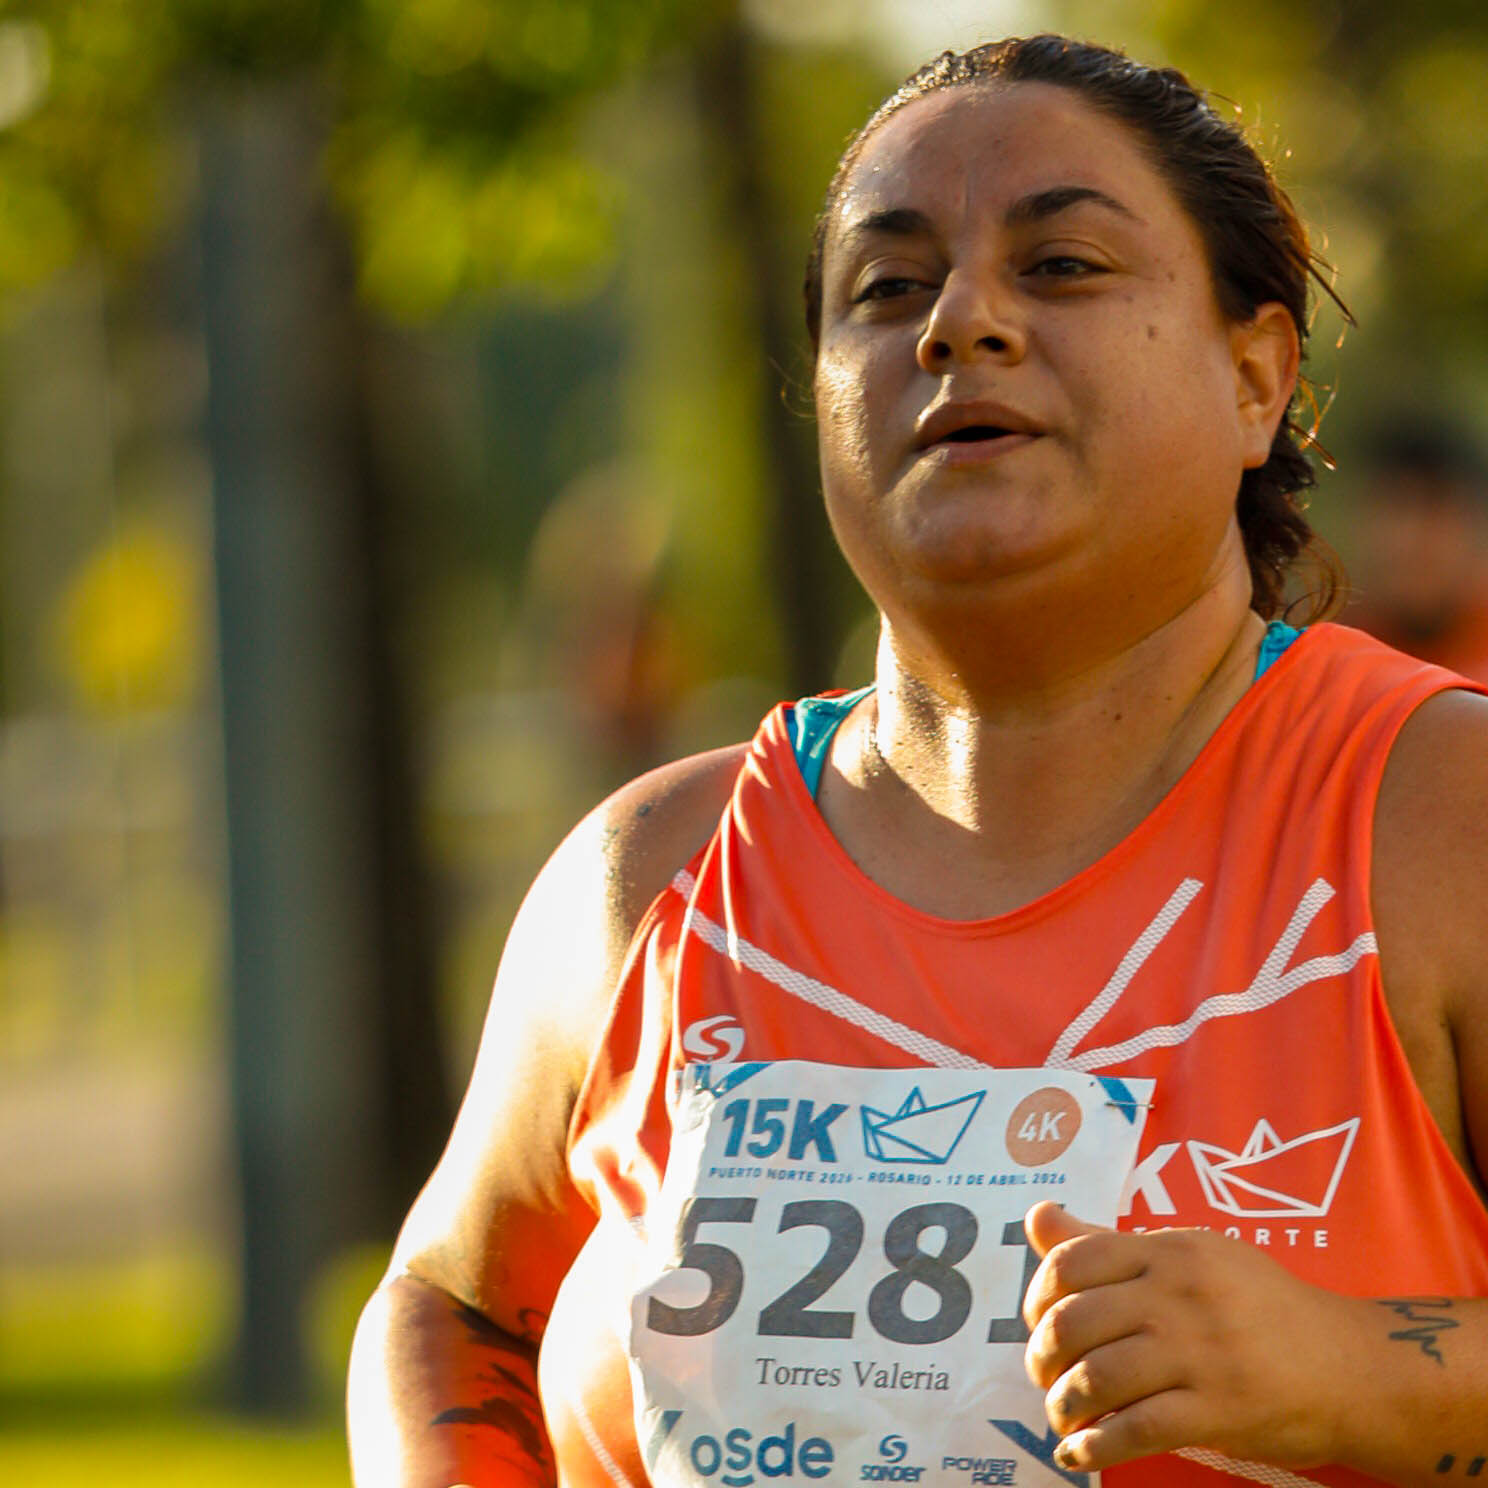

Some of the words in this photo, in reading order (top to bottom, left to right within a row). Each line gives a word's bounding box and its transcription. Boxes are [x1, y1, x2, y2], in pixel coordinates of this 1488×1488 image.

[722, 1098, 850, 1163] 15K
[1016, 1111, 1067, 1144] 4K
[708, 1166, 762, 1179] PUERTO
[766, 1167, 817, 1182] NORTE
[867, 1172, 932, 1186] ROSARIO
[946, 1174, 962, 1186] 12
[965, 1174, 985, 1186] DE
[1197, 1226, 1328, 1248] ORTE
[755, 1357, 841, 1388] Torres
[852, 1361, 950, 1391] Valeria
[690, 1421, 835, 1482] osde
